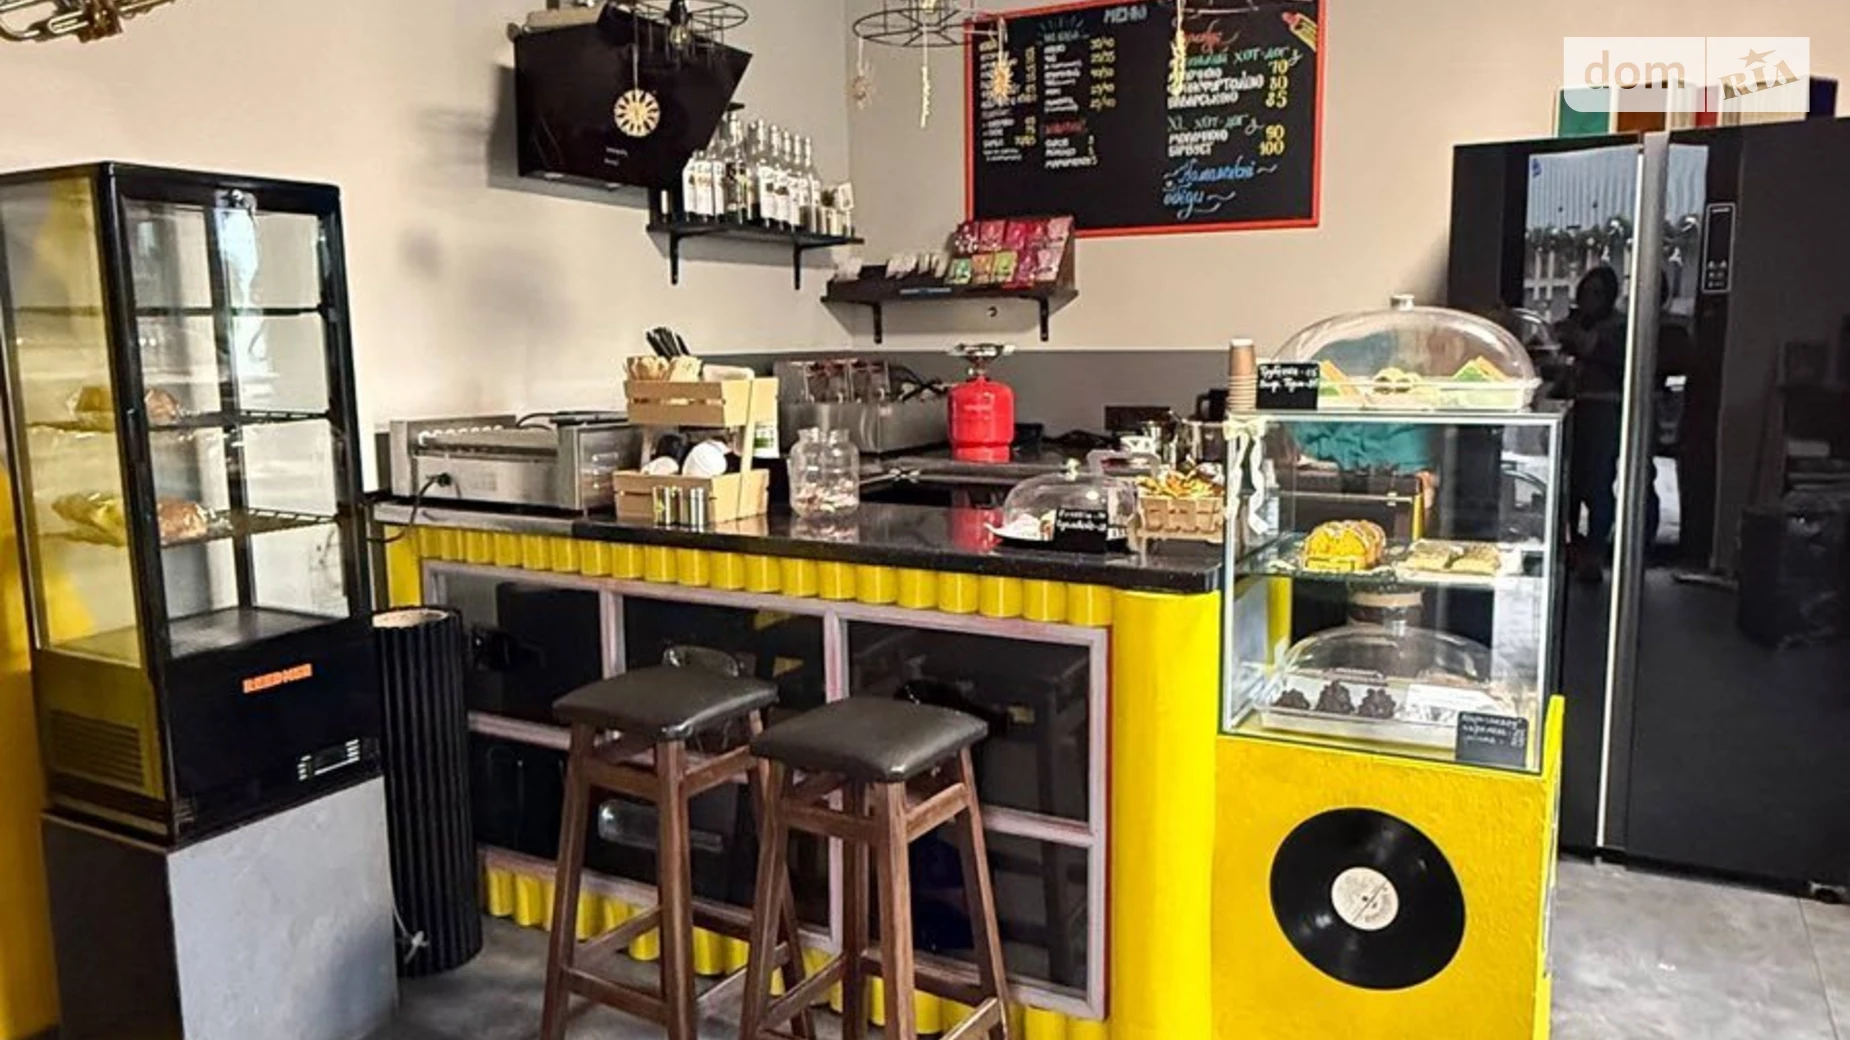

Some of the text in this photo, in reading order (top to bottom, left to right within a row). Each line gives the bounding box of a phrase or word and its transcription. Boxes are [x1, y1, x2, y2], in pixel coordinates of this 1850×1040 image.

[1268, 59, 1289, 74] 70
[1269, 75, 1289, 90] 80
[1265, 91, 1288, 108] 85
[1265, 125, 1285, 140] 90
[1259, 141, 1285, 156] 100
